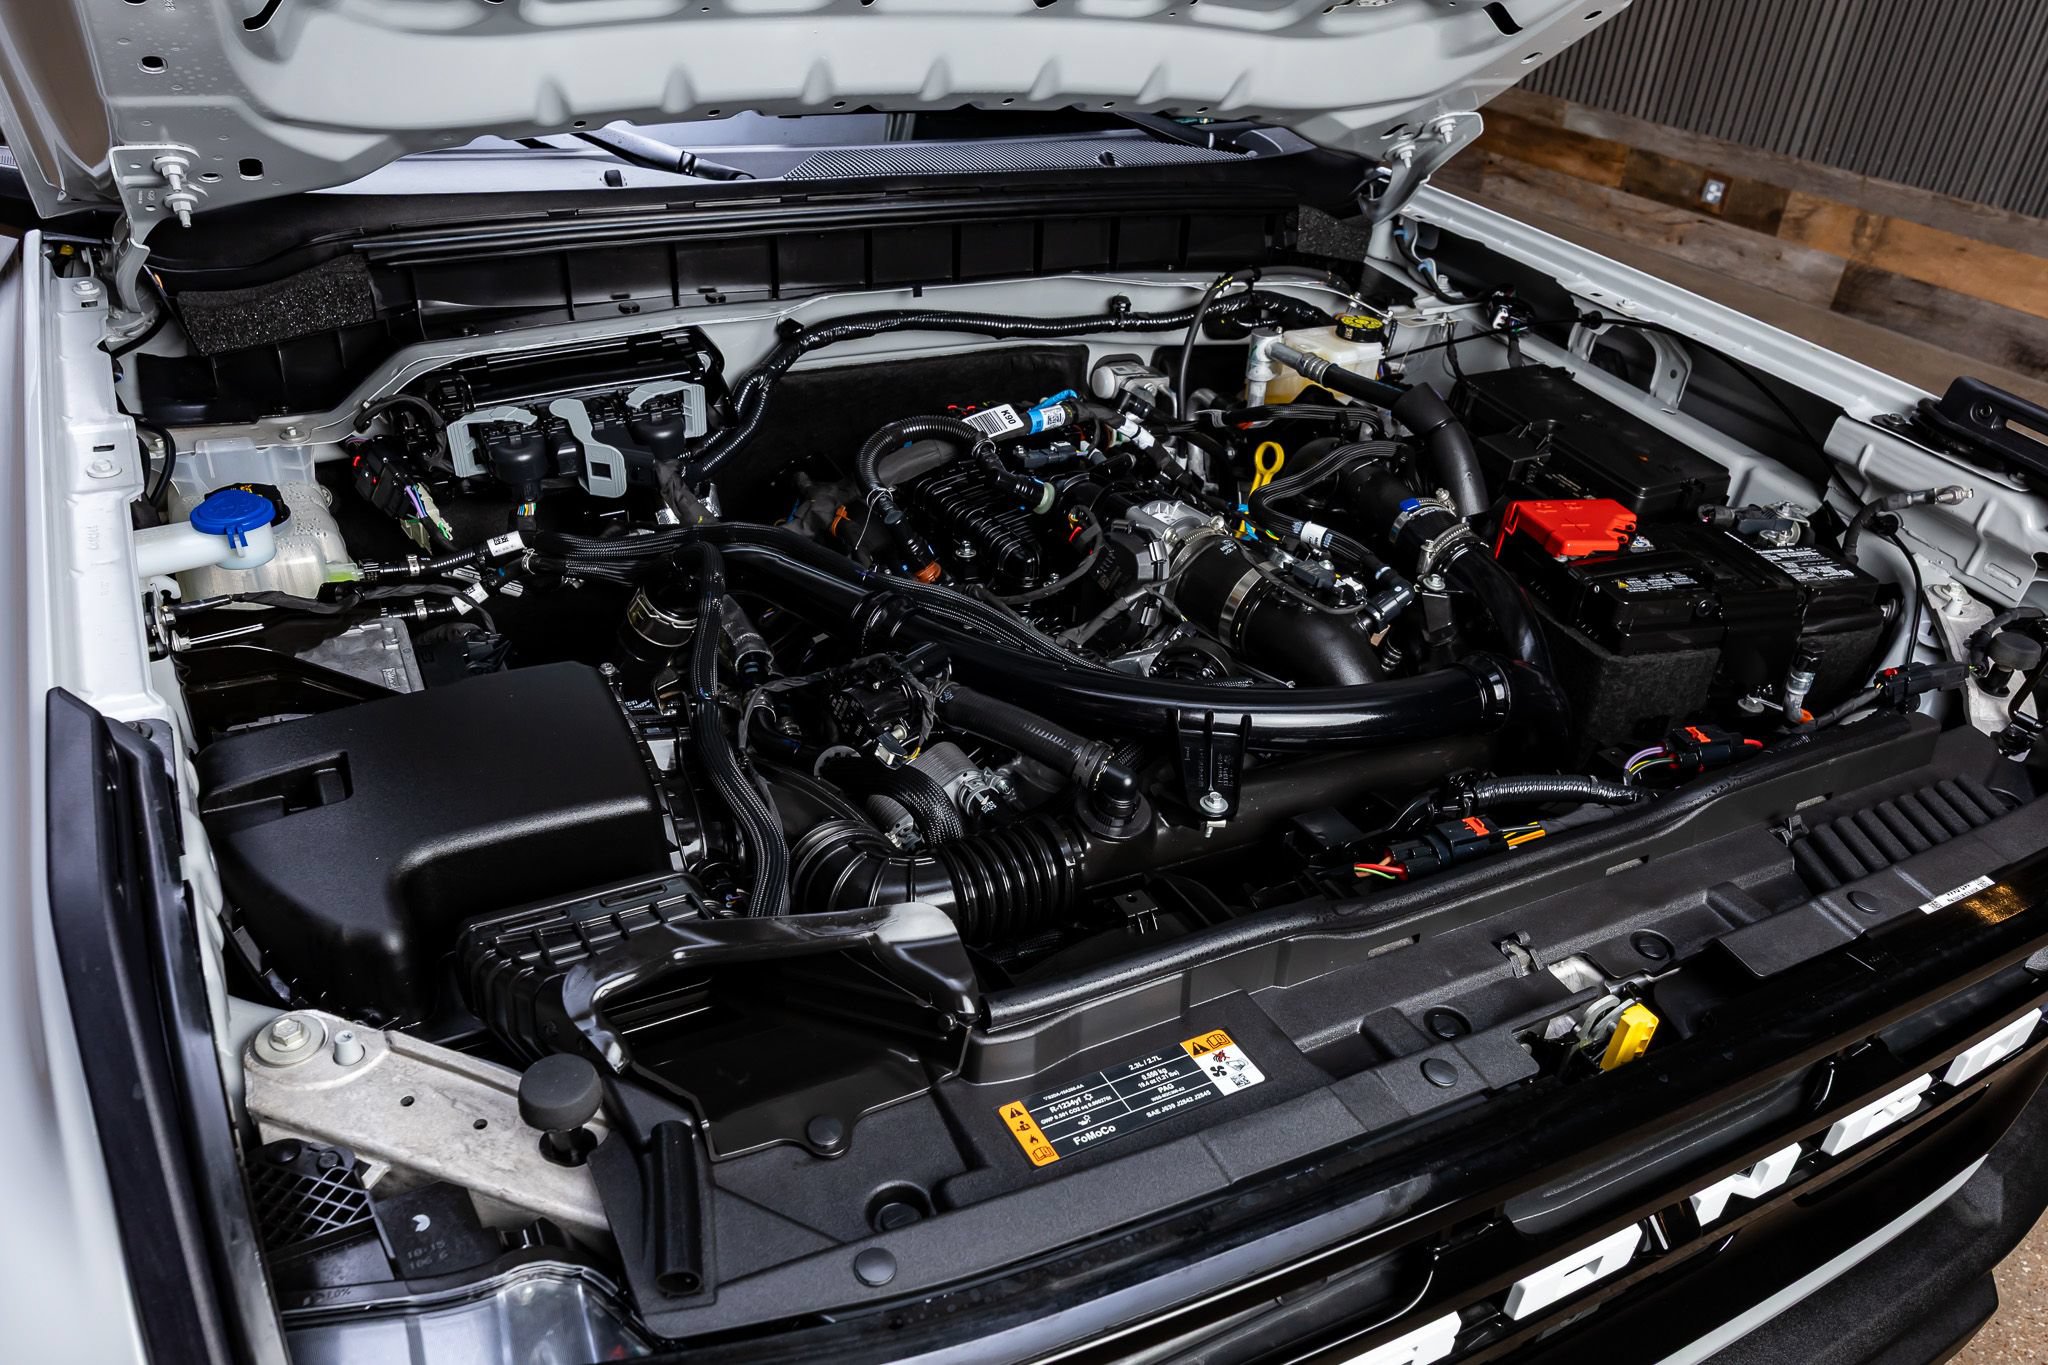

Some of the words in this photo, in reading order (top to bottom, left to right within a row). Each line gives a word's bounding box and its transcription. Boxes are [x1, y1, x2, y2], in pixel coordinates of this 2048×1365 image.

[1128, 1061, 1144, 1070] 2.3L
[1147, 1055, 1162, 1064] 2.7L
[1158, 1083, 1174, 1093] PAG
[1049, 1097, 1082, 1113] R-1234yf
[1146, 1109, 1161, 1118] SAE
[1073, 1125, 1116, 1145] FoMoCo
